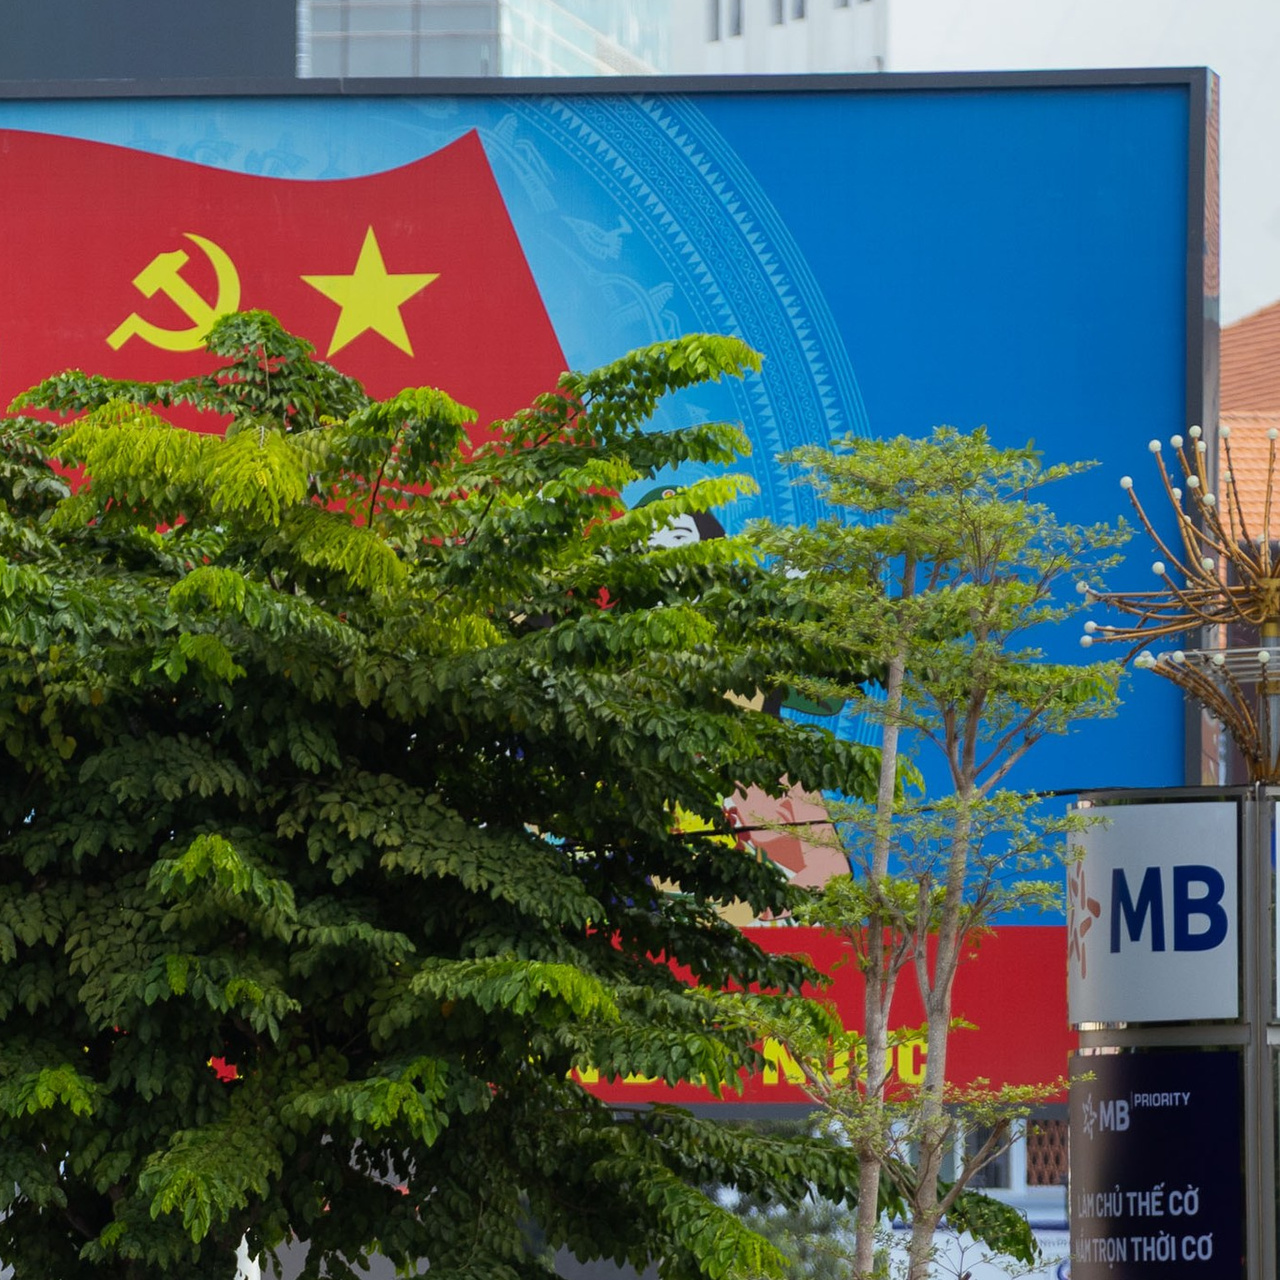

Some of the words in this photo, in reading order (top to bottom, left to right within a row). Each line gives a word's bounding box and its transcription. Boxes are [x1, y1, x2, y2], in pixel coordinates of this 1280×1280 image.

[1110, 865, 1229, 954] MB
[1099, 1100, 1130, 1132] MB
[1134, 1092, 1191, 1108] PRIORITY
[1096, 1184, 1122, 1218] CHỦ
[1126, 1182, 1166, 1217] THẾ
[1169, 1184, 1199, 1217] CỜ
[1092, 1236, 1127, 1269] TRỌN
[1131, 1230, 1176, 1262] THỜI
[1182, 1232, 1213, 1262] CƠ
